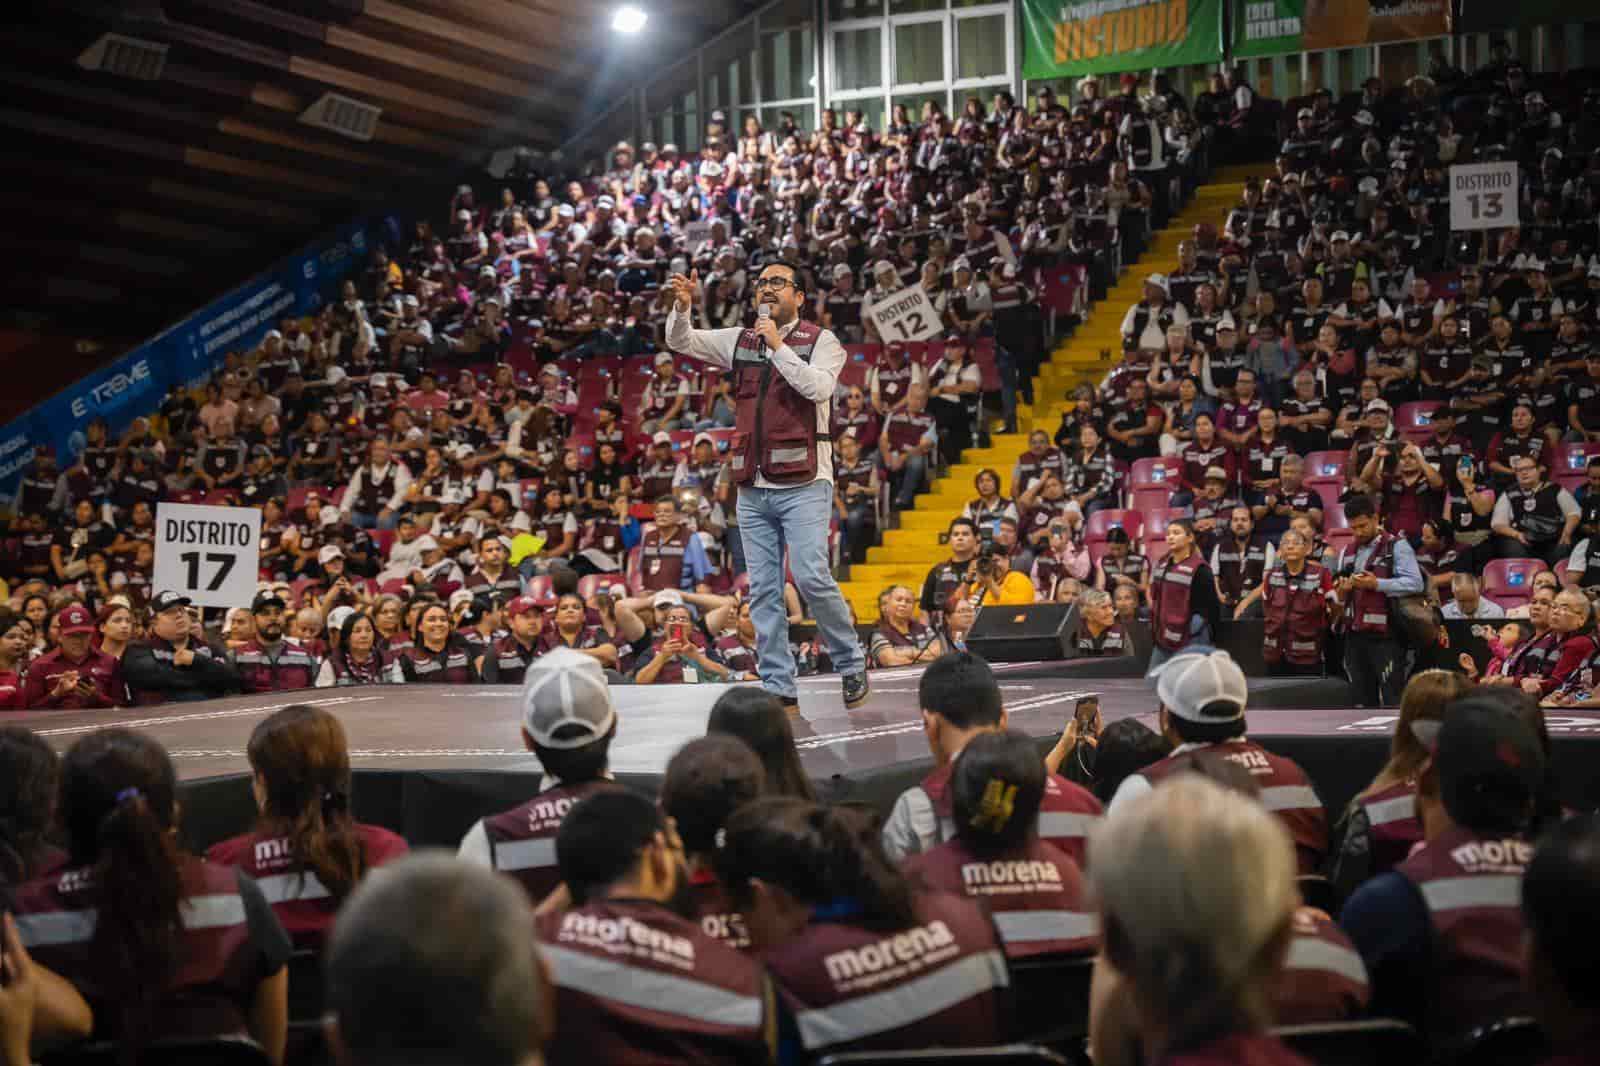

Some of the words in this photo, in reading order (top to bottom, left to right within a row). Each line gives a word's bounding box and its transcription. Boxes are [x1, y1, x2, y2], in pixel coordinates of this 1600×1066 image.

[1455, 172, 1511, 190] DISTRITO
[1466, 192, 1503, 219] 13
[876, 293, 922, 322] DISTRITO
[893, 312, 928, 339] 12
[165, 519, 251, 546] DISTRITO
[180, 551, 237, 592] 17
[961, 860, 1063, 884] morena
[562, 912, 696, 961] morena
[823, 919, 956, 982] morena
